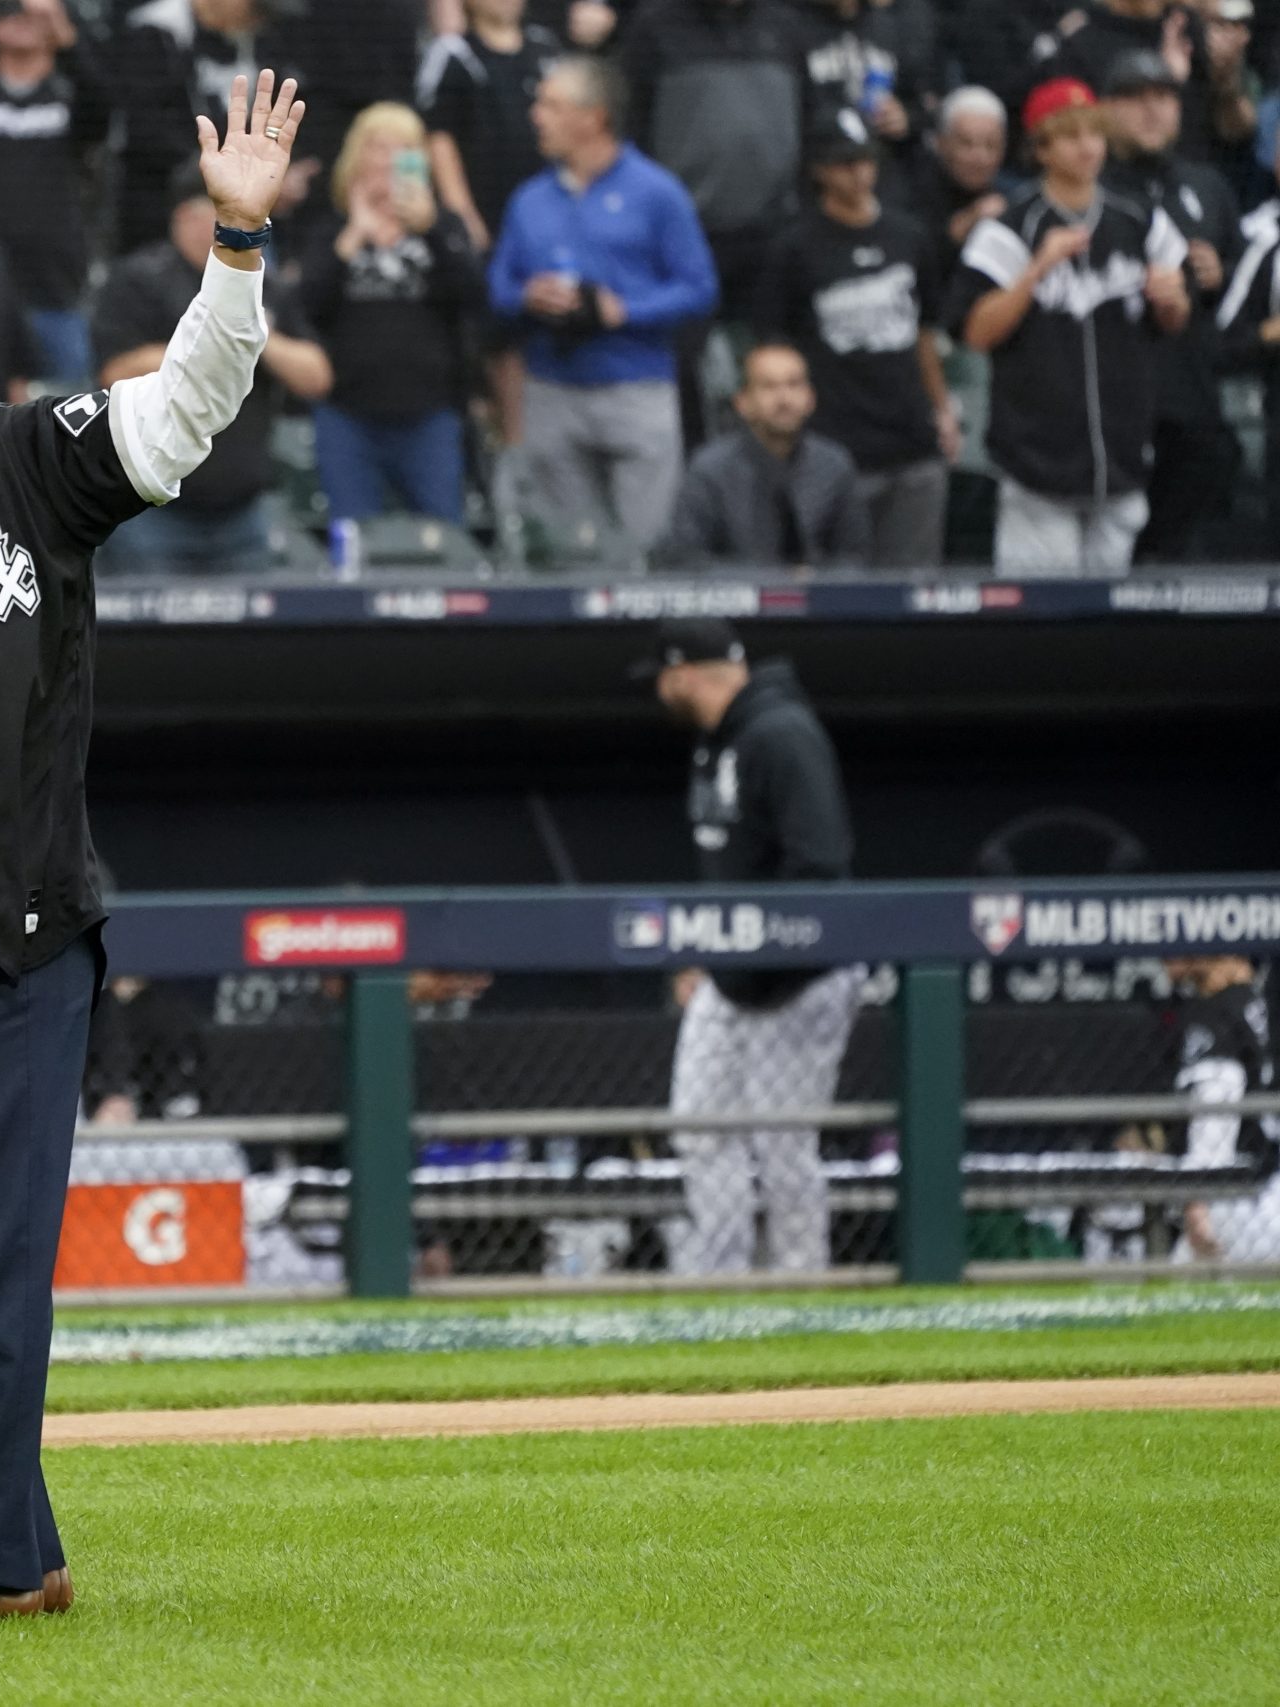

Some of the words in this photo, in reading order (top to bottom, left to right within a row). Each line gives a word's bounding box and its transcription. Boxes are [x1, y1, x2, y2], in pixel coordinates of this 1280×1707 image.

[668, 903, 765, 952] MLB
[1024, 898, 1108, 948] MLB
[122, 1188, 187, 1266] G
